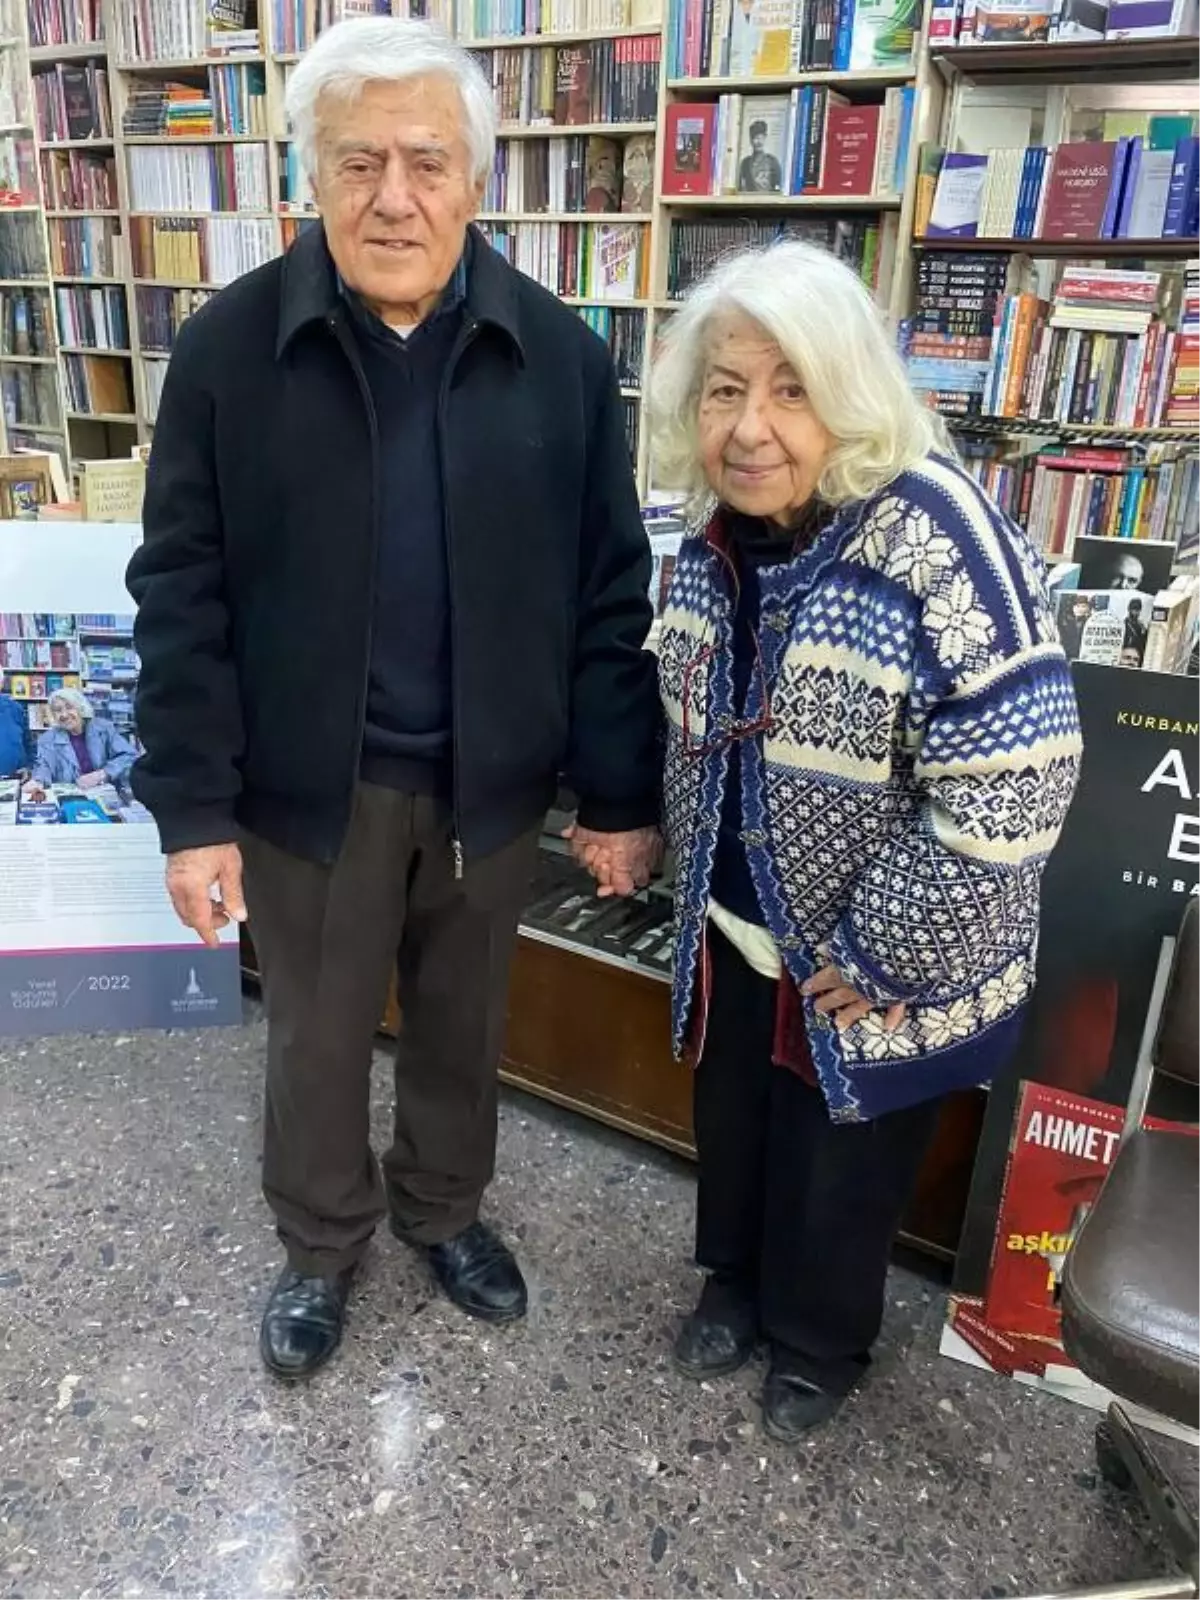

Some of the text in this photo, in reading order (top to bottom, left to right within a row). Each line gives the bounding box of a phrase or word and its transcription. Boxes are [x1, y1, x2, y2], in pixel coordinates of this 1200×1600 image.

[1116, 711, 1200, 736] KURBAN
[1140, 748, 1200, 800] A
[1167, 812, 1200, 862] E
[1122, 869, 1200, 896] BİR BA
[88, 975, 131, 990] 2022
[1024, 1110, 1120, 1165] AHMET
